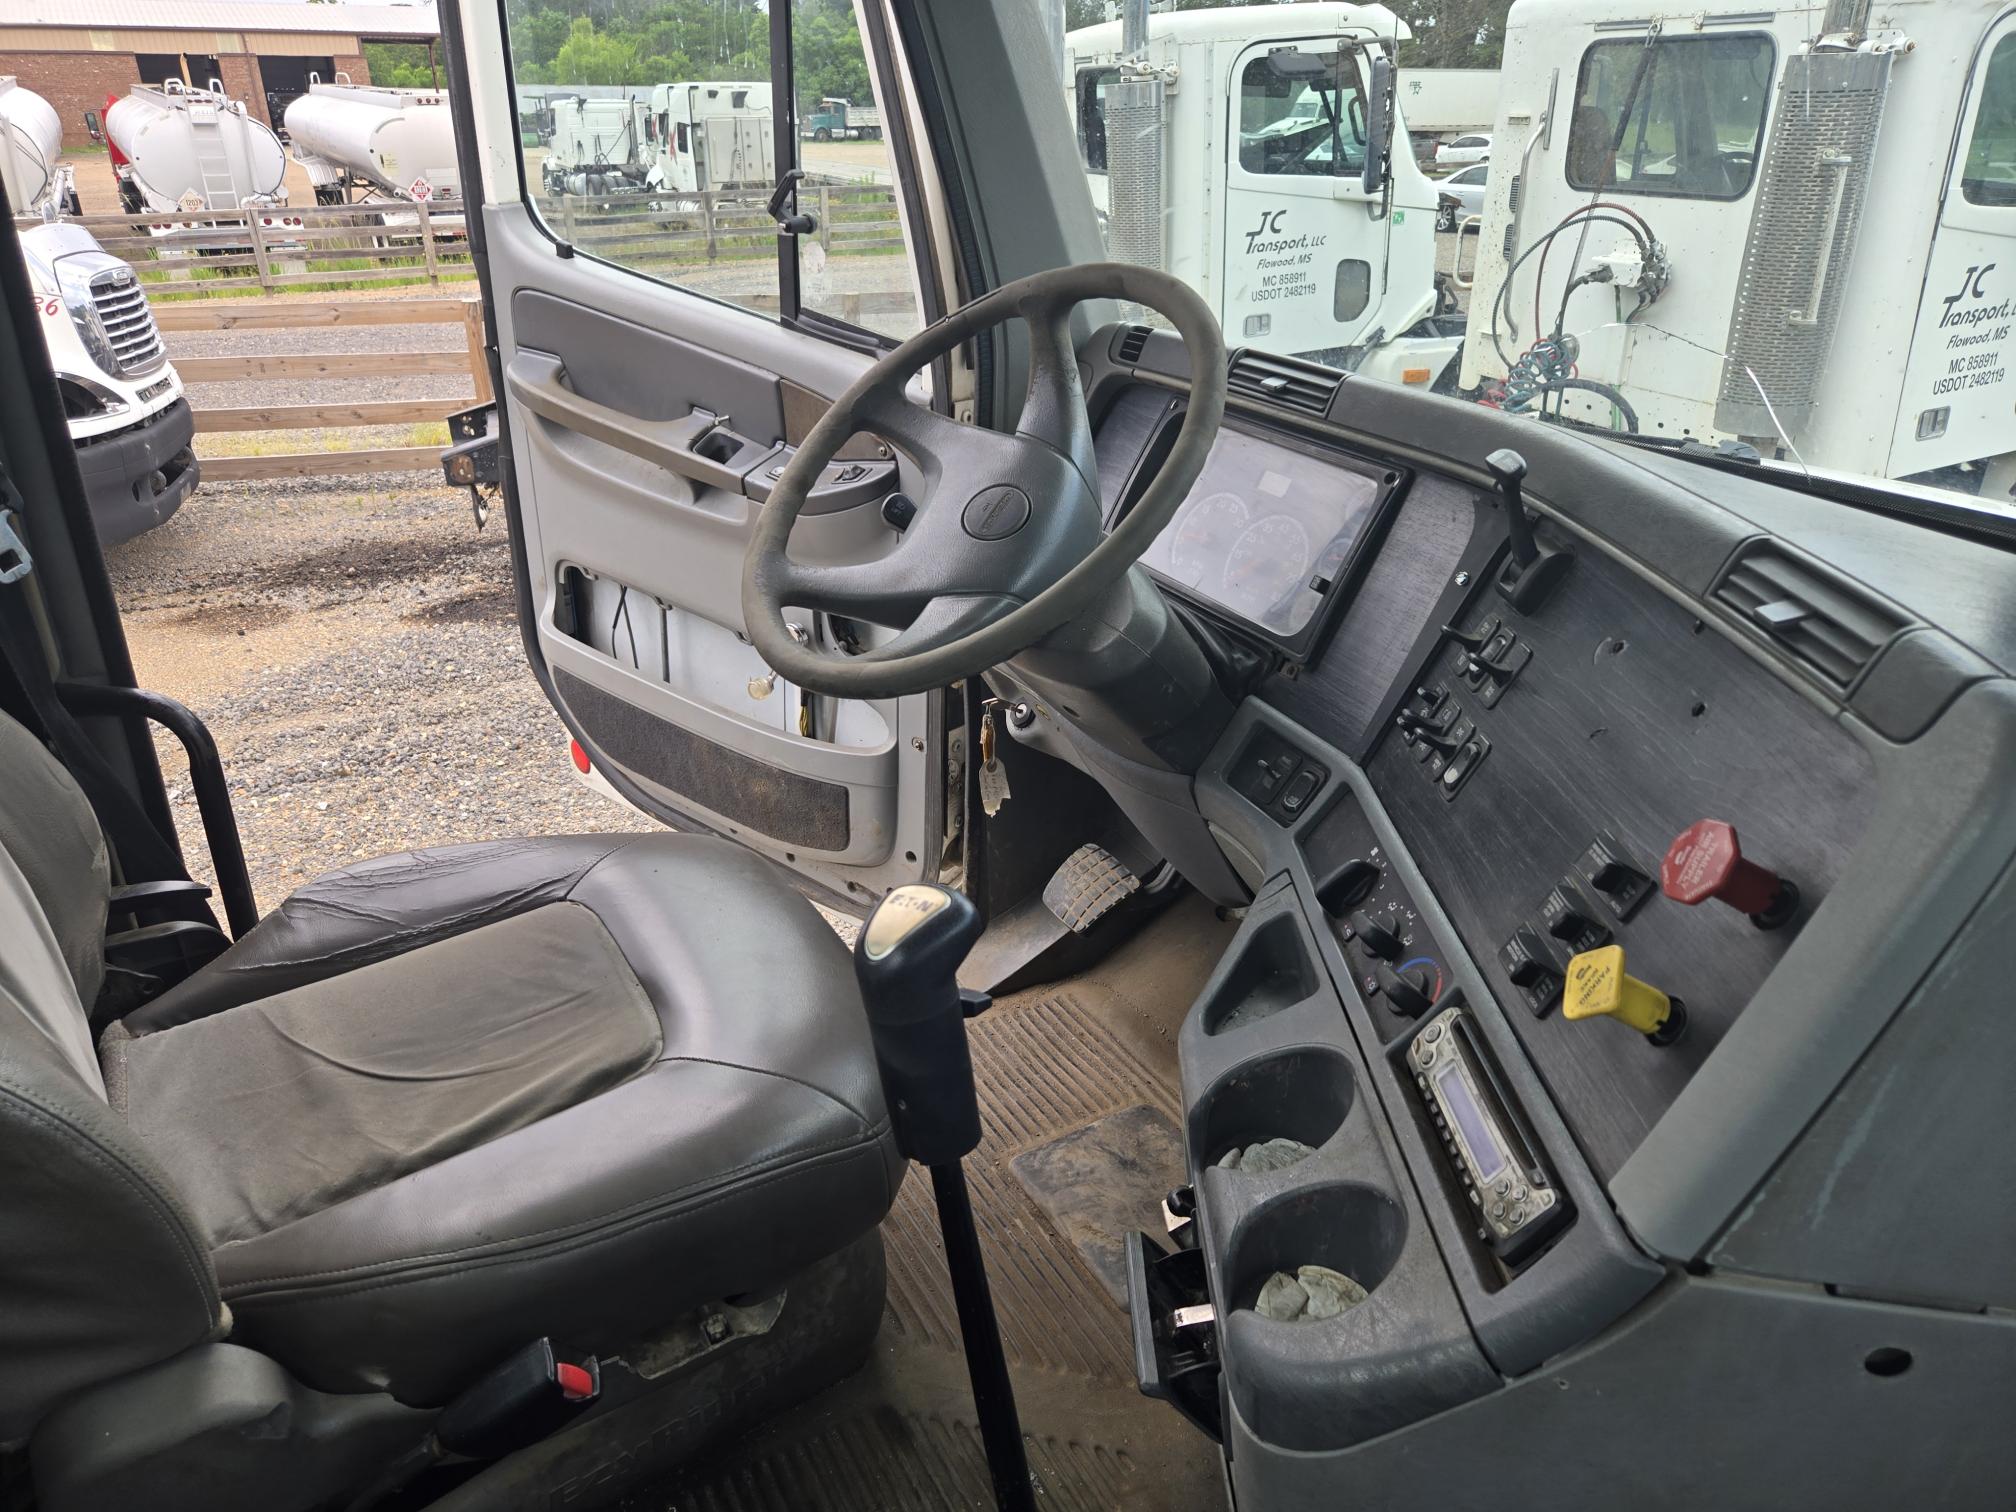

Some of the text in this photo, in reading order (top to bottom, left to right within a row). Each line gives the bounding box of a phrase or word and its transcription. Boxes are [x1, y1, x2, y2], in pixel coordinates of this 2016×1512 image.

[1252, 209, 1287, 235] JC
[1245, 231, 1327, 254] Transport, LLC
[1256, 253, 1313, 270] Flowood, MS
[1262, 272, 1307, 288] MC 858911
[1951, 263, 1996, 301] JC
[1251, 283, 1317, 303] USDOT 2482119
[1938, 296, 2009, 329] Transport,
[1946, 325, 2011, 350] Flowood, MS
[1948, 351, 1999, 375] MC 858911
[1932, 367, 2005, 396] USDOT 2482119
[1578, 965, 1612, 1007] PARKING
